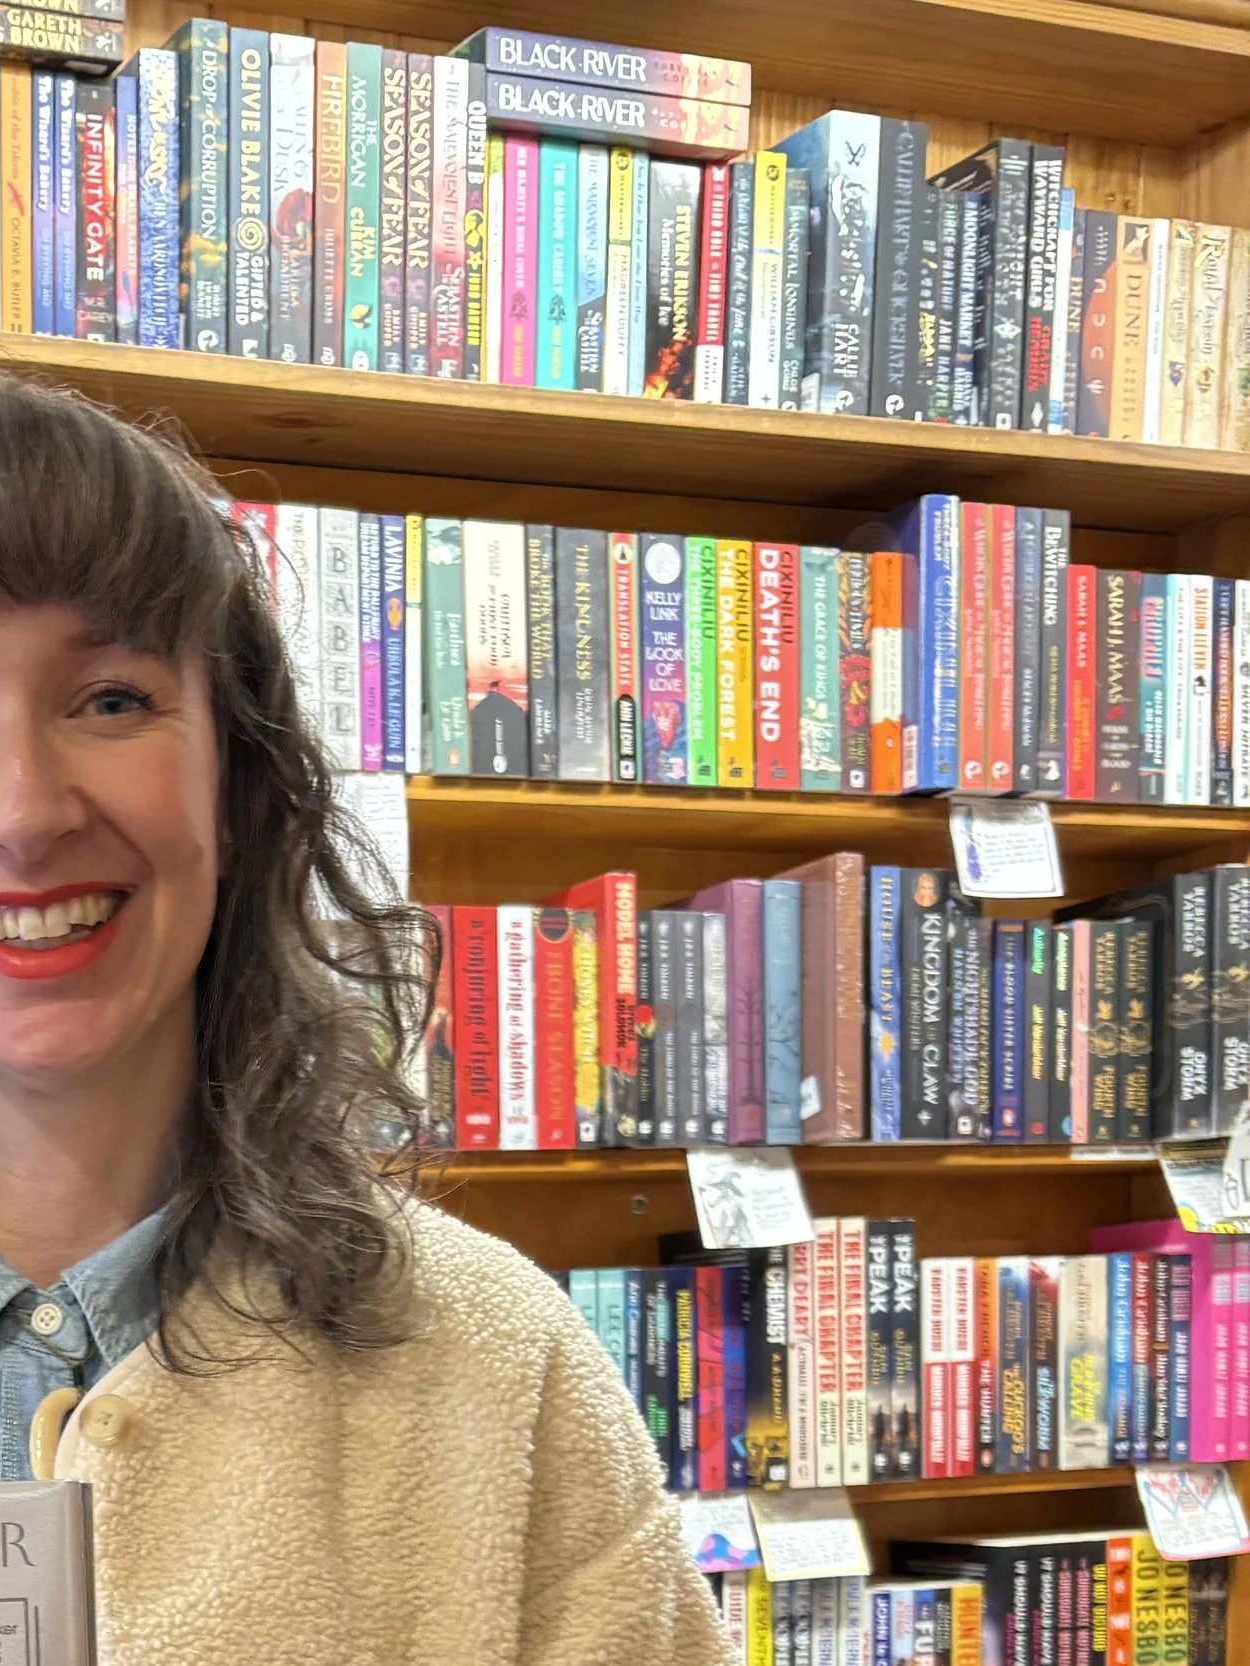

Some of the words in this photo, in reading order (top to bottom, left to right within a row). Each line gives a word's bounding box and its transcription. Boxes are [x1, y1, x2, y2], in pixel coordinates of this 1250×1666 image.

[8, 10, 81, 36] GARETH
[9, 25, 80, 52] BROWN
[240, 48, 262, 136] OLIVIE
[500, 37, 576, 71] BLACK
[583, 49, 646, 81] RIVER
[321, 74, 344, 203] FIREBIRD
[351, 76, 366, 188] MORRIGAN
[384, 68, 405, 178] SEASON
[466, 101, 486, 163] QUEEN
[499, 83, 575, 117] BLACK
[581, 95, 645, 127] RIVER
[85, 114, 105, 215] INFINITY
[240, 141, 260, 216] BLAKE
[382, 196, 402, 266] FEAR
[676, 204, 691, 264] STEVEN
[1031, 161, 1048, 252] WAYWARD
[1045, 161, 1061, 275] WITCHCRAFT
[86, 218, 104, 281] GATE
[1030, 256, 1044, 308] GIRLS
[673, 270, 690, 342] ERIKSON
[382, 523, 403, 592] LAVINIA
[718, 549, 734, 588] THE
[719, 596, 735, 651] DARK
[759, 549, 780, 672] DEATH'S
[719, 660, 734, 741] FOREST
[761, 682, 780, 742] END
[922, 912, 942, 1023] KINGDOM
[924, 1043, 940, 1105] CLAW
[766, 1267, 786, 1344] CHEMIST
[818, 1316, 837, 1392] CHAPTER
[1138, 1550, 1157, 1578] JO
